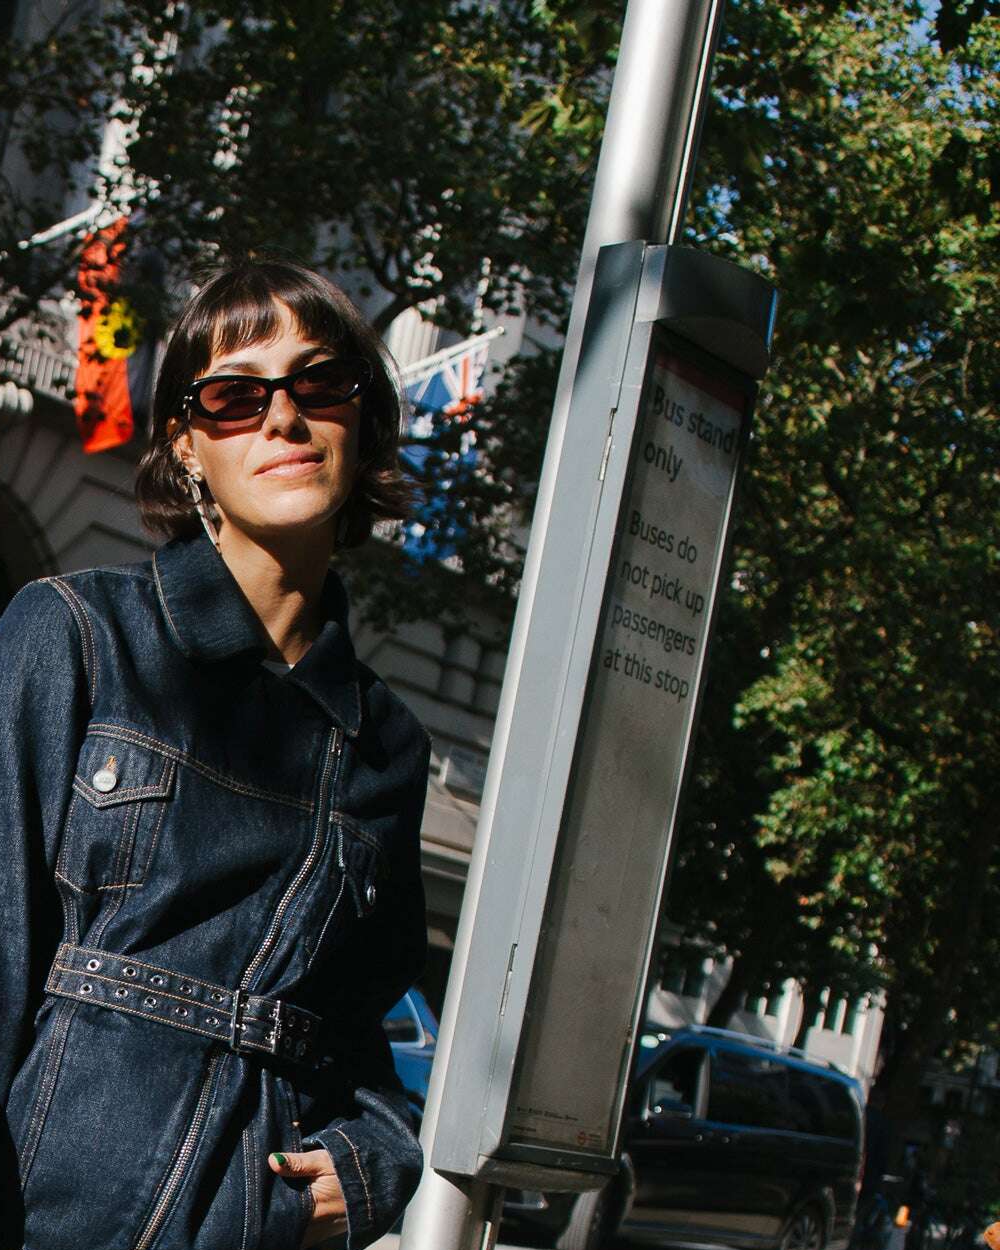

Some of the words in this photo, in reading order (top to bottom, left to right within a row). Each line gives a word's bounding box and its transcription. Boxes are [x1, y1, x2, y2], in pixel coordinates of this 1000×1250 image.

[653, 385, 684, 427] Bus
[687, 412, 736, 454] stand
[644, 441, 682, 482] only
[630, 510, 674, 553] Buses
[677, 535, 697, 563] do
[621, 561, 650, 589] not
[649, 573, 683, 604] pick
[685, 590, 704, 618] up
[612, 604, 696, 655] passengers
[603, 648, 622, 671] at
[624, 653, 652, 684] this
[655, 669, 689, 704] stop
